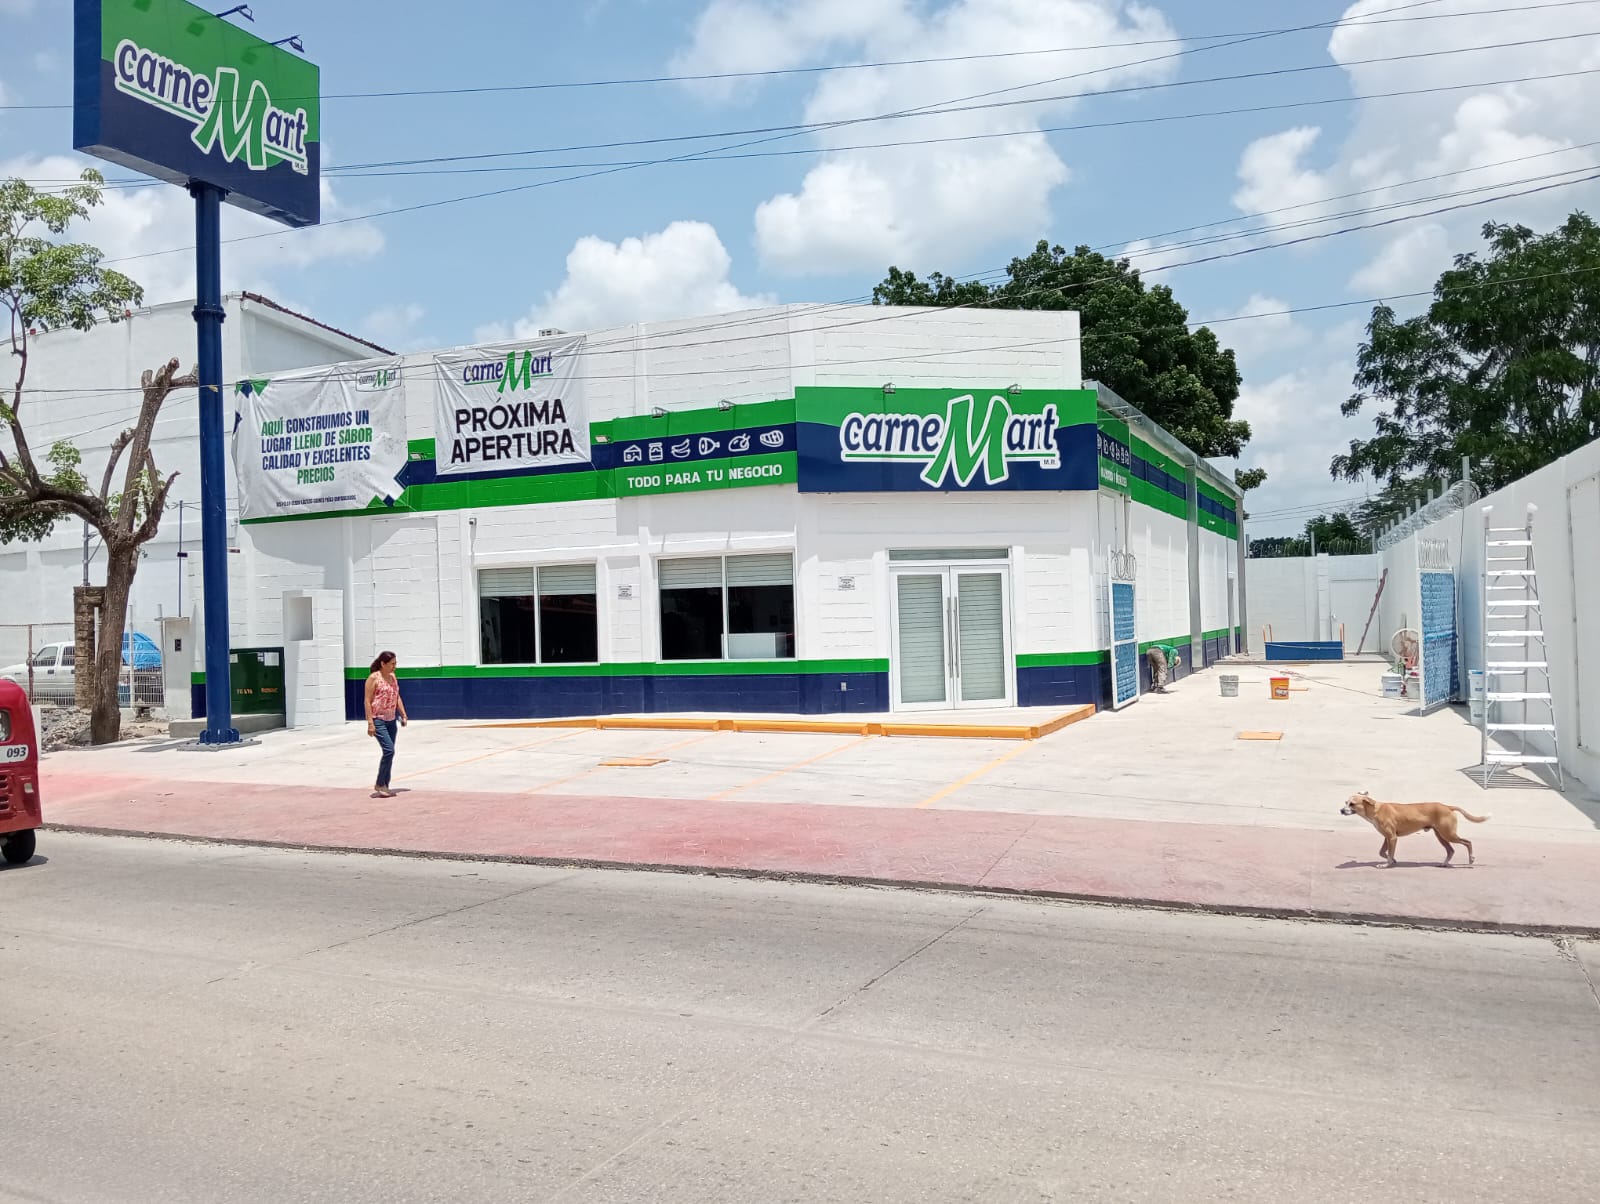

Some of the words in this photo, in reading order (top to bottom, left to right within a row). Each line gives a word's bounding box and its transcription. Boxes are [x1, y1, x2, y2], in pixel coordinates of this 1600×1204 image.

[261, 416, 284, 436] AQUÍ
[286, 411, 352, 433] CONSTRUIMOS
[355, 410, 369, 426] UN
[455, 397, 566, 434] PRÓXIMA
[261, 438, 292, 453] LUGAR
[294, 433, 322, 450] LLENO
[325, 431, 336, 446] DE
[338, 427, 373, 445] SABOR
[451, 428, 575, 464] APERTURA
[262, 453, 300, 470] CALIDAD
[304, 453, 310, 466] Y
[312, 446, 371, 465] EXCELENTES
[297, 466, 335, 484] PRECIOS
[627, 475, 661, 489] TODO
[665, 472, 701, 486] PARA
[706, 469, 724, 482] TU
[728, 463, 783, 480] NEGOCIO
[6, 746, 26, 758] 093
